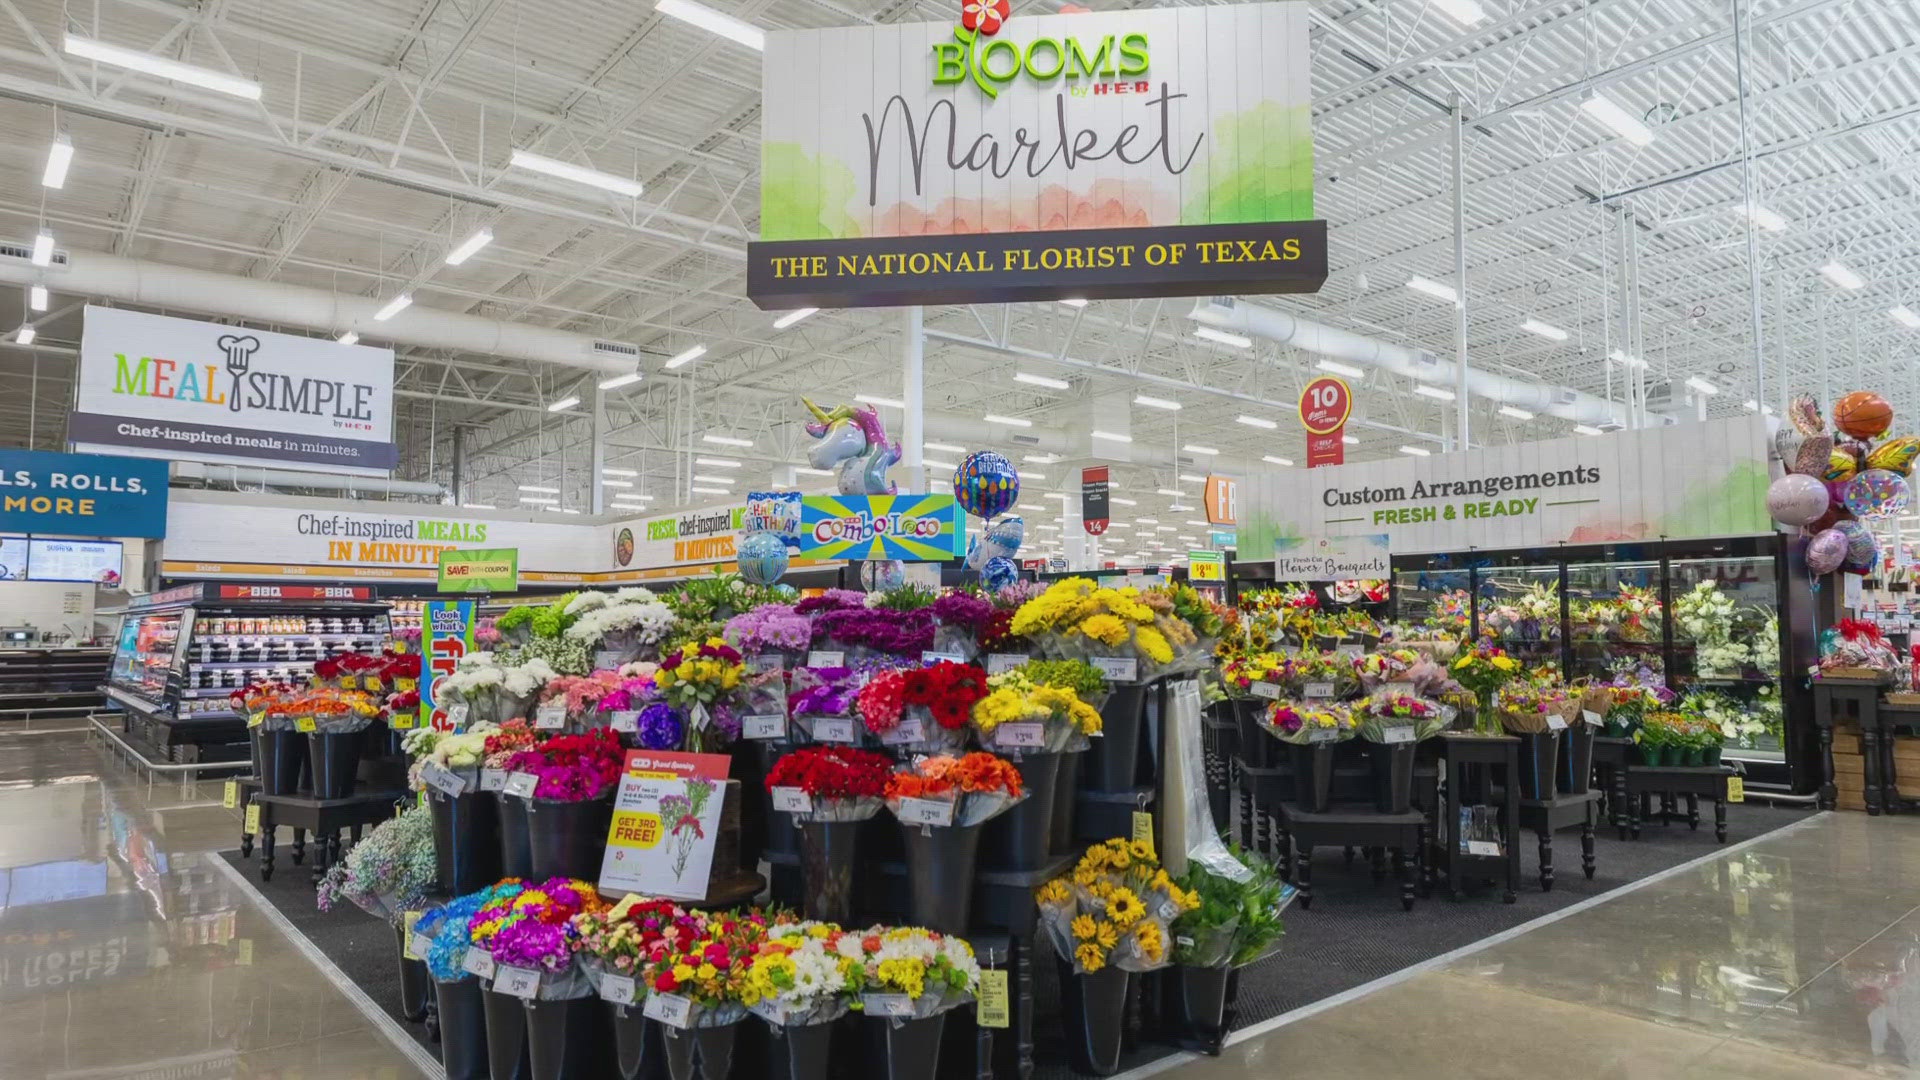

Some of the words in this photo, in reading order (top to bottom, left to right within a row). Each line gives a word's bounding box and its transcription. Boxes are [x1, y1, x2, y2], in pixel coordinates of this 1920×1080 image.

[931, 28, 1151, 98] BLOOMS
[1070, 85, 1088, 98] by
[861, 81, 1204, 207] Market
[771, 256, 828, 279] THE
[836, 250, 994, 277] NATIONAL
[1002, 245, 1135, 271] FLORIST
[1143, 243, 1186, 266] OF
[1196, 238, 1301, 264] TEXAS
[112, 353, 225, 405] MEAL
[247, 372, 372, 421] SIMPLE
[1310, 385, 1338, 409] 10
[117, 423, 232, 448] Chef-inspired
[234, 432, 282, 450] meals
[284, 437, 298, 451] in
[300, 439, 361, 457] minutes.
[50, 473, 148, 495] ROLLS,
[1322, 487, 1406, 508] Custom
[1410, 465, 1601, 500] Arrangements
[4, 496, 96, 516] MORE
[1373, 505, 1437, 526] FRESH
[1443, 504, 1457, 521] &
[1463, 498, 1539, 519] READY
[297, 513, 414, 541] Chef-inspired
[417, 519, 487, 543] MEALS
[679, 508, 731, 537] chef-inspired
[813, 511, 888, 543] Combo
[1089, 521, 1102, 532] 14
[328, 541, 354, 561] IN
[485, 565, 509, 573] COUPON
[1280, 558, 1321, 577] Flower
[1325, 557, 1386, 575] Bouquets
[250, 586, 282, 597] BBQ
[325, 587, 354, 598] BBQ
[433, 609, 461, 621] Look
[431, 621, 466, 632] what's
[625, 783, 642, 792] BUY
[618, 816, 637, 827] GET
[639, 818, 657, 829] 3RD
[615, 827, 656, 843] FREE!
